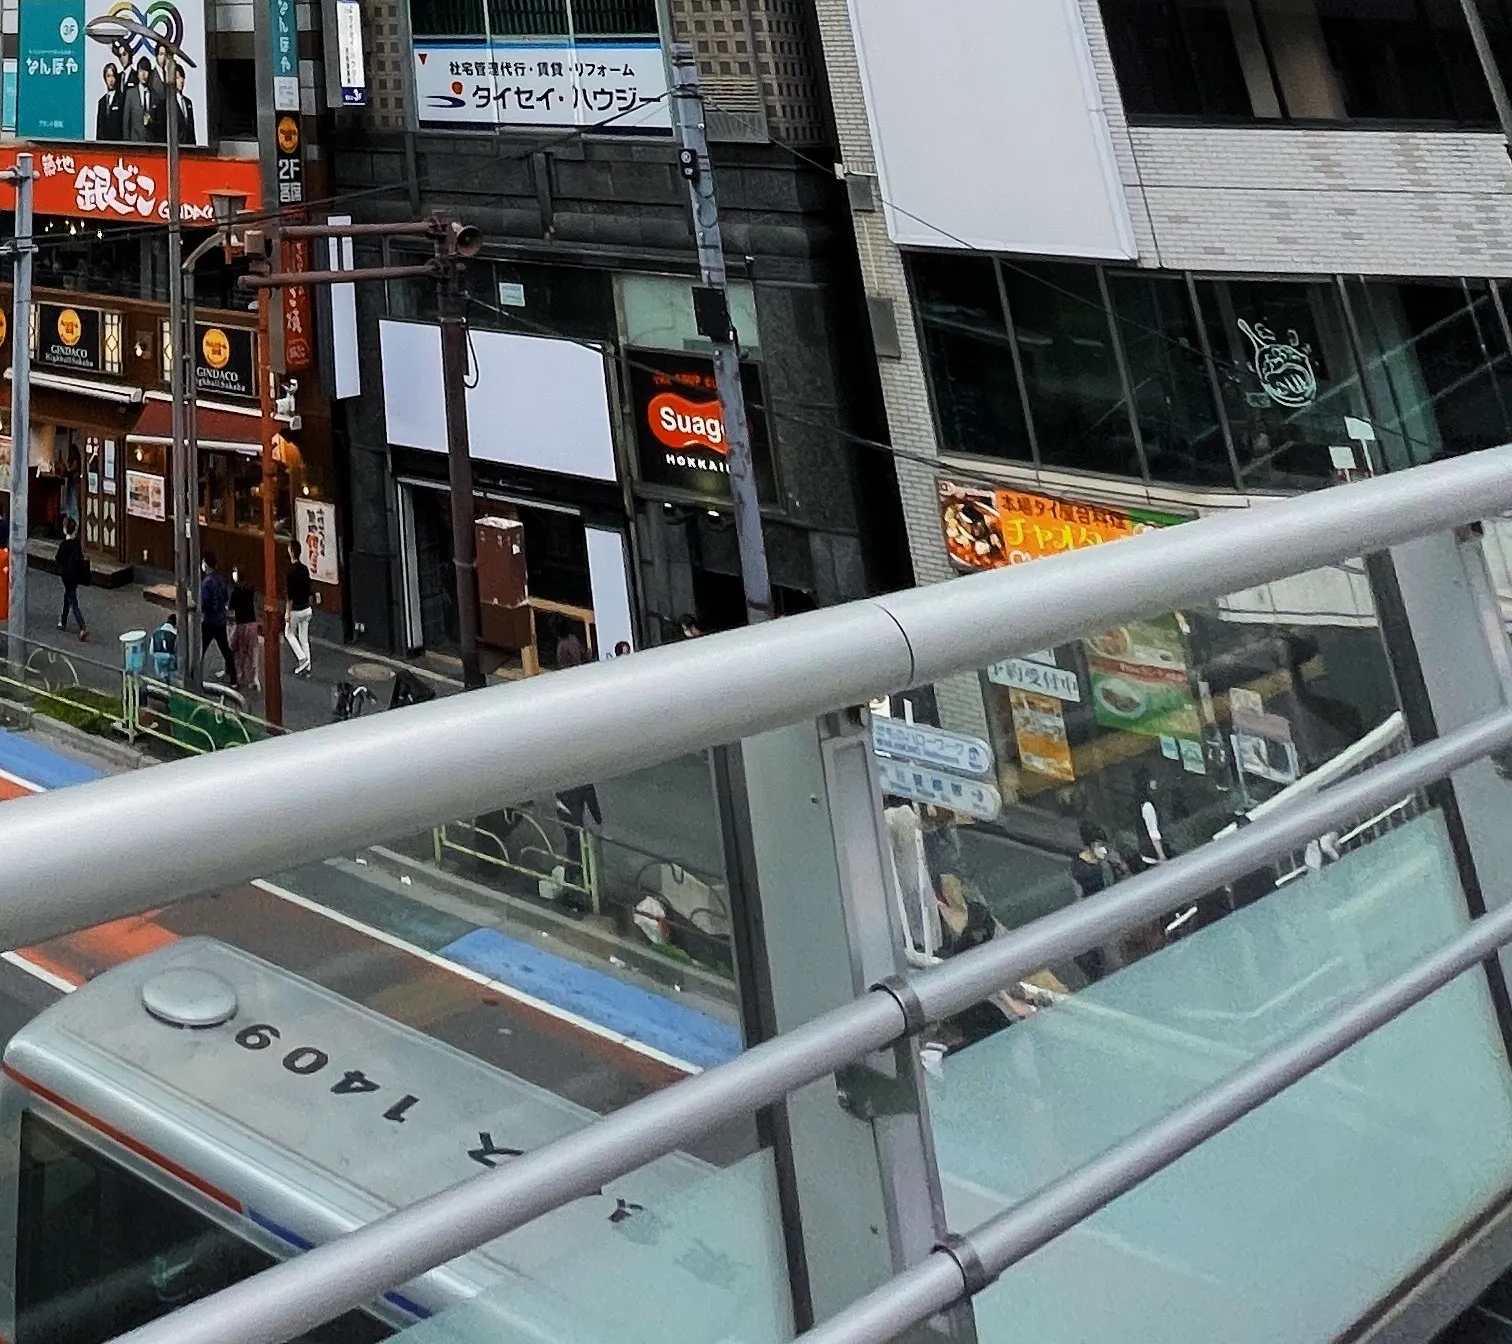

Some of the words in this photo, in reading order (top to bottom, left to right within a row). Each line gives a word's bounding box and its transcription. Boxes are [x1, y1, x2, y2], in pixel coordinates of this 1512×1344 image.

[26, 56, 79, 76] なんぼや
[472, 84, 661, 112] タイセイ・ハウジー
[278, 159, 301, 180] 2F
[74, 158, 157, 216] 銀だこ
[50, 344, 88, 359] GINDACO
[196, 367, 238, 382] GINDACO
[659, 406, 726, 444] Suag
[665, 454, 731, 474] HOKKAI
